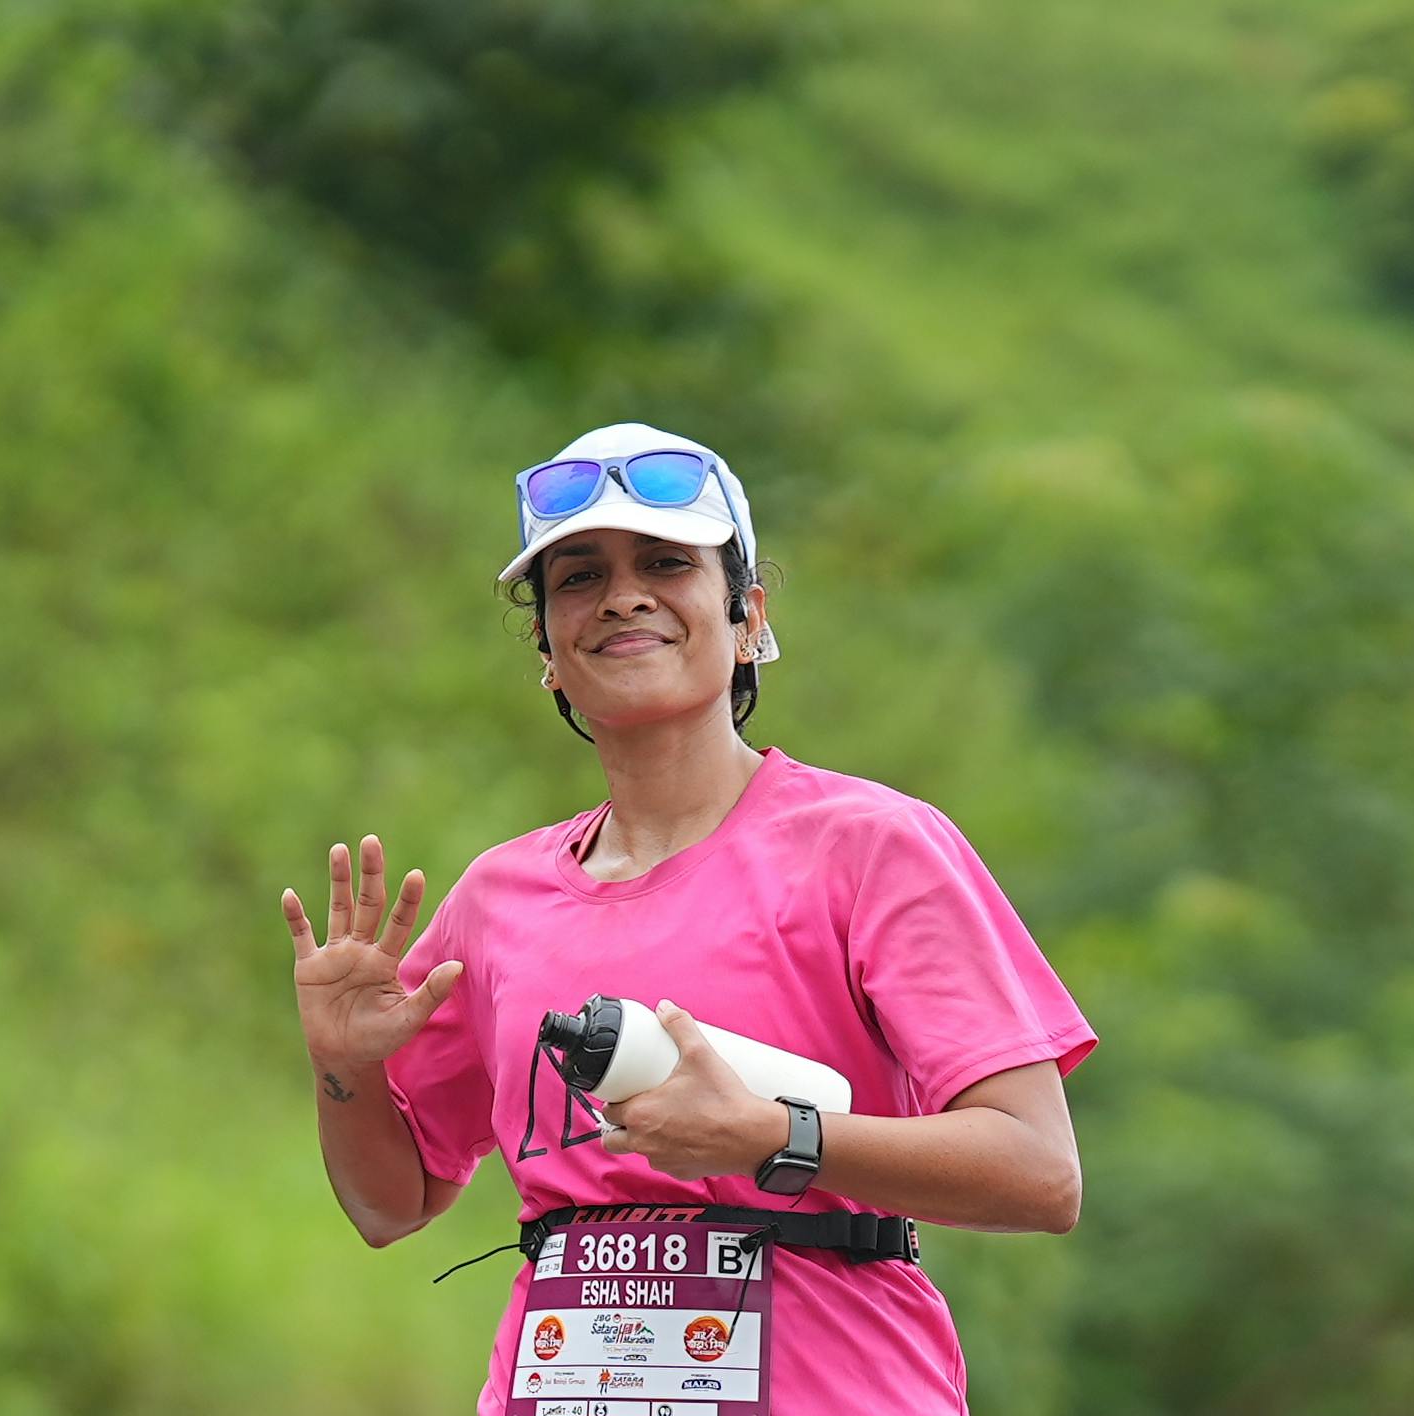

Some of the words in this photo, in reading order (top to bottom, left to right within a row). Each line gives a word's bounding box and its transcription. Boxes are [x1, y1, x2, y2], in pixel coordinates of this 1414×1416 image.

[577, 1233, 687, 1272] 36818
[718, 1244, 743, 1274] B
[580, 1280, 620, 1306] ESHA
[625, 1280, 674, 1306] SHAH
